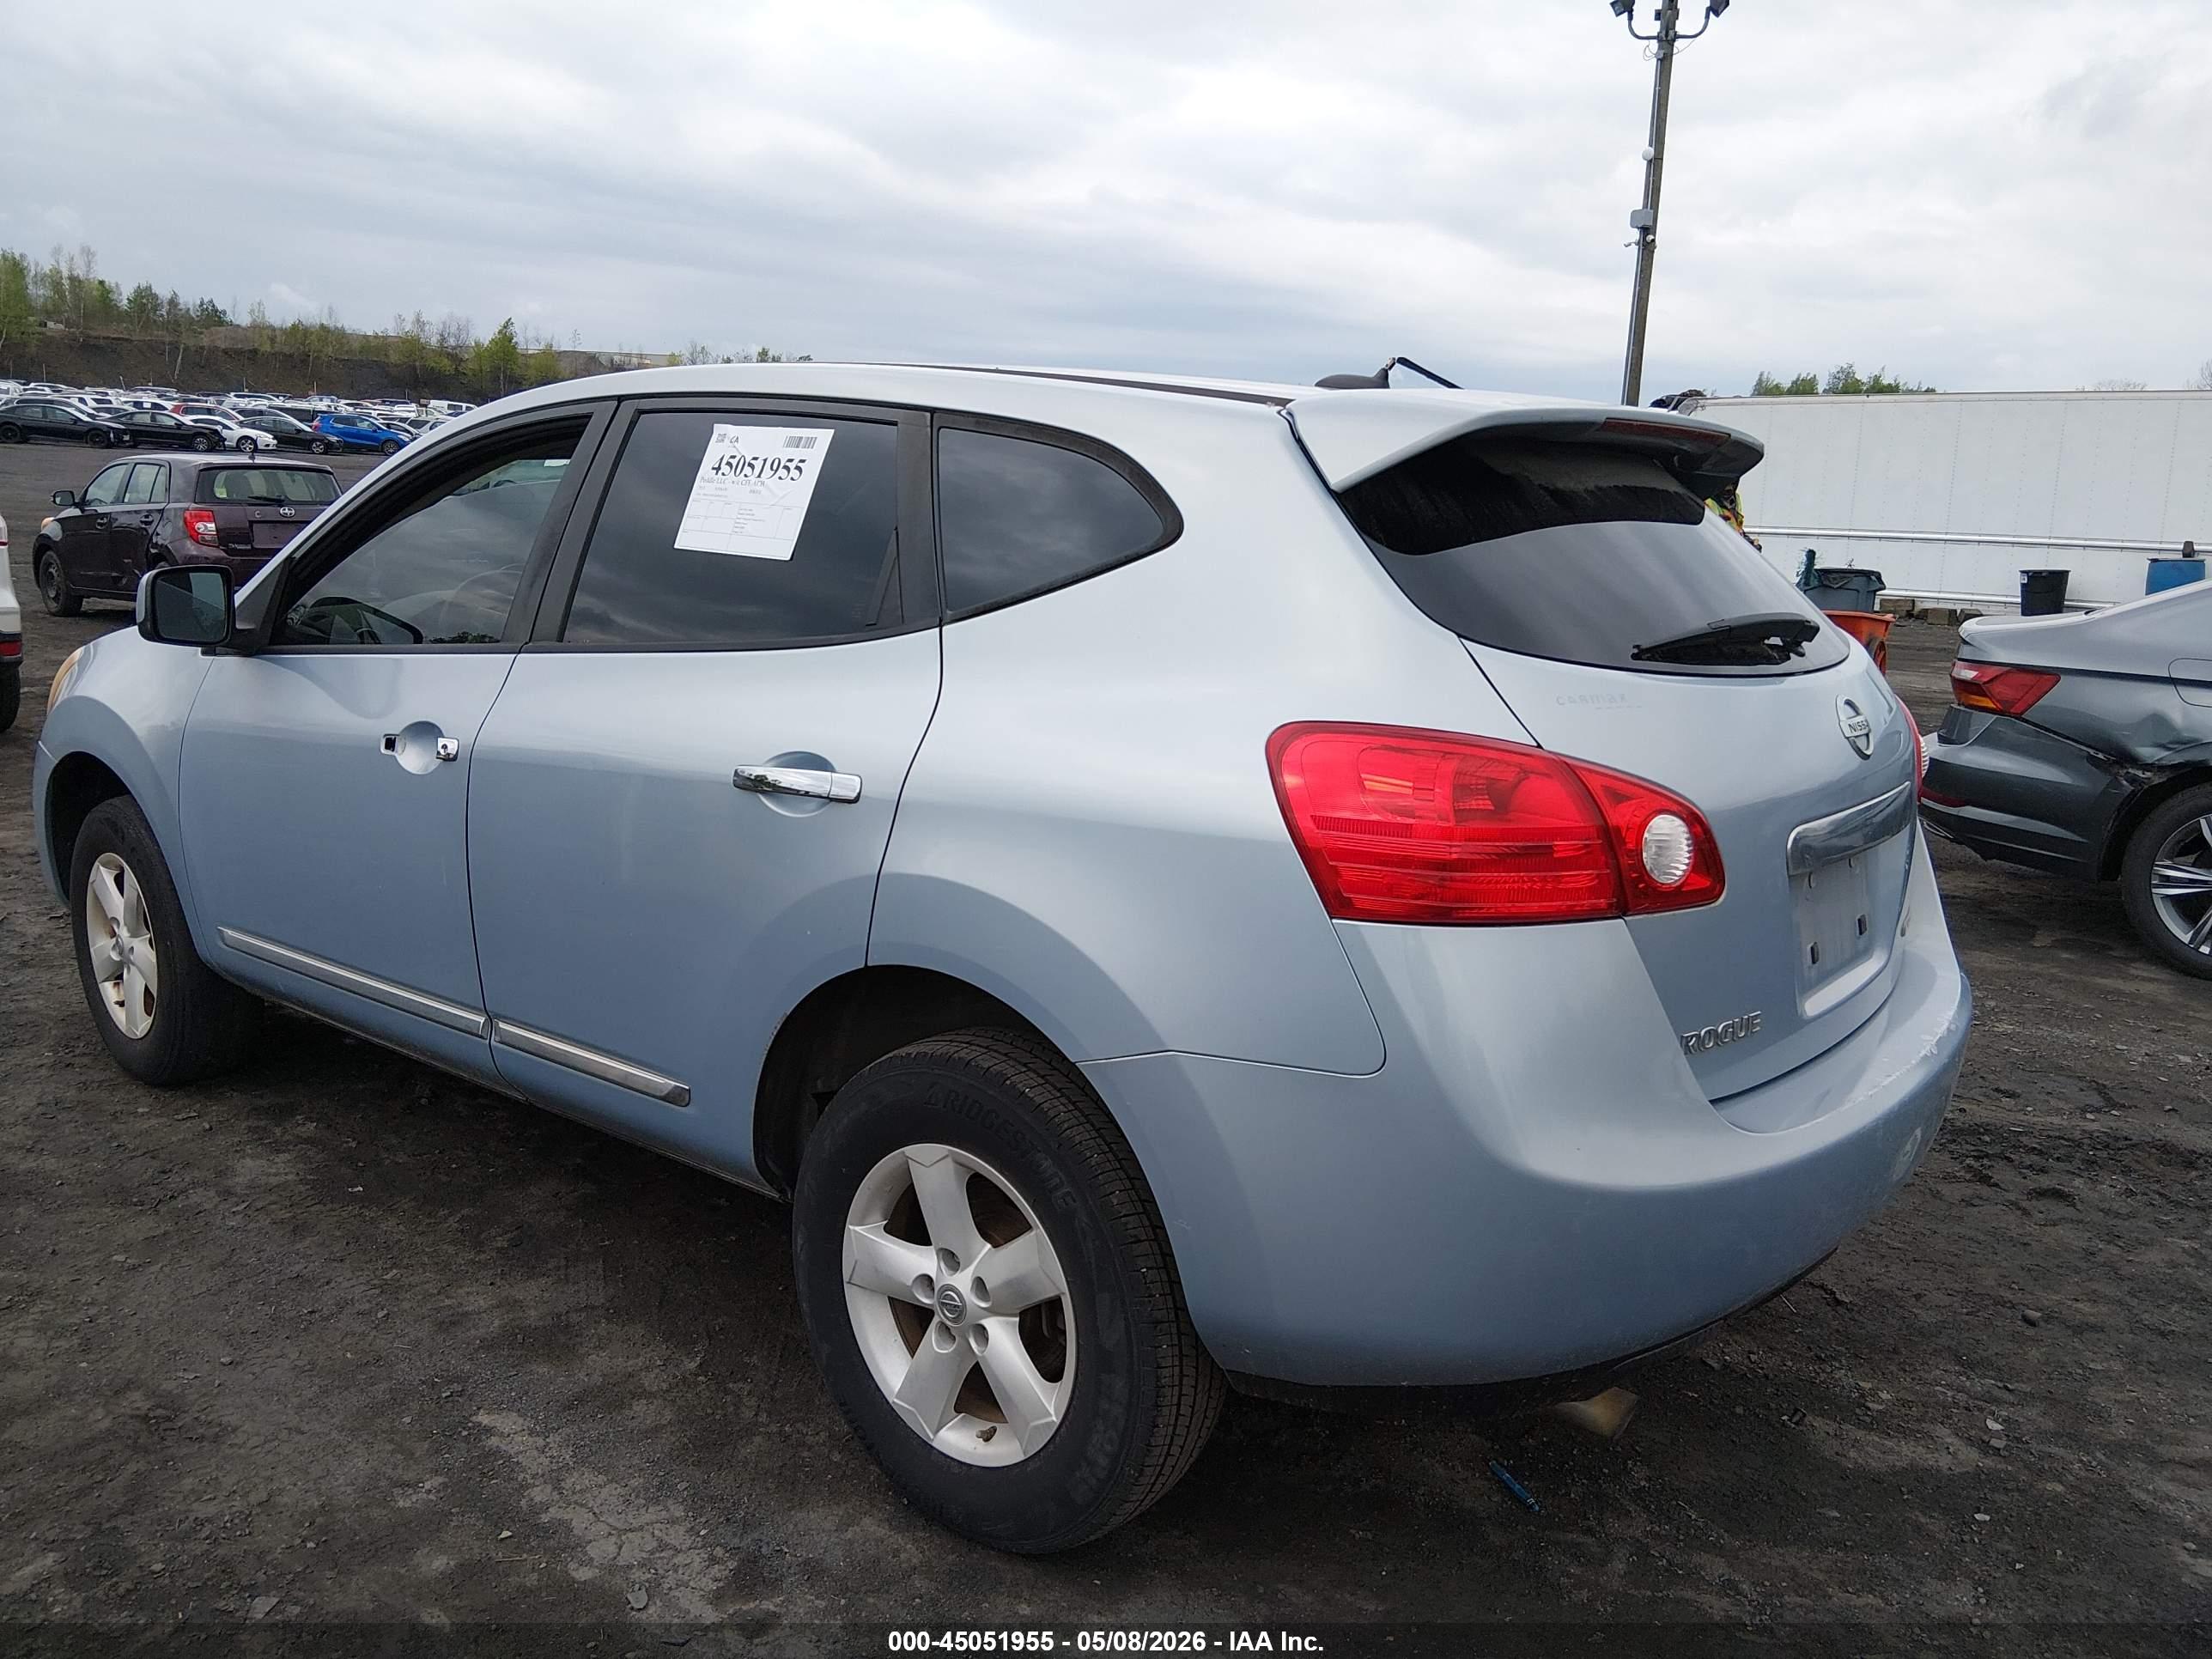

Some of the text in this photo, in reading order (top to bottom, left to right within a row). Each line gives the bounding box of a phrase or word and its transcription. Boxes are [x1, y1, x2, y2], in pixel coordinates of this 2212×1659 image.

[711, 454, 807, 482] 45051955
[1680, 1011, 1762, 1055] ROGUE
[923, 1080, 1079, 1212] BRIDGESTONE
